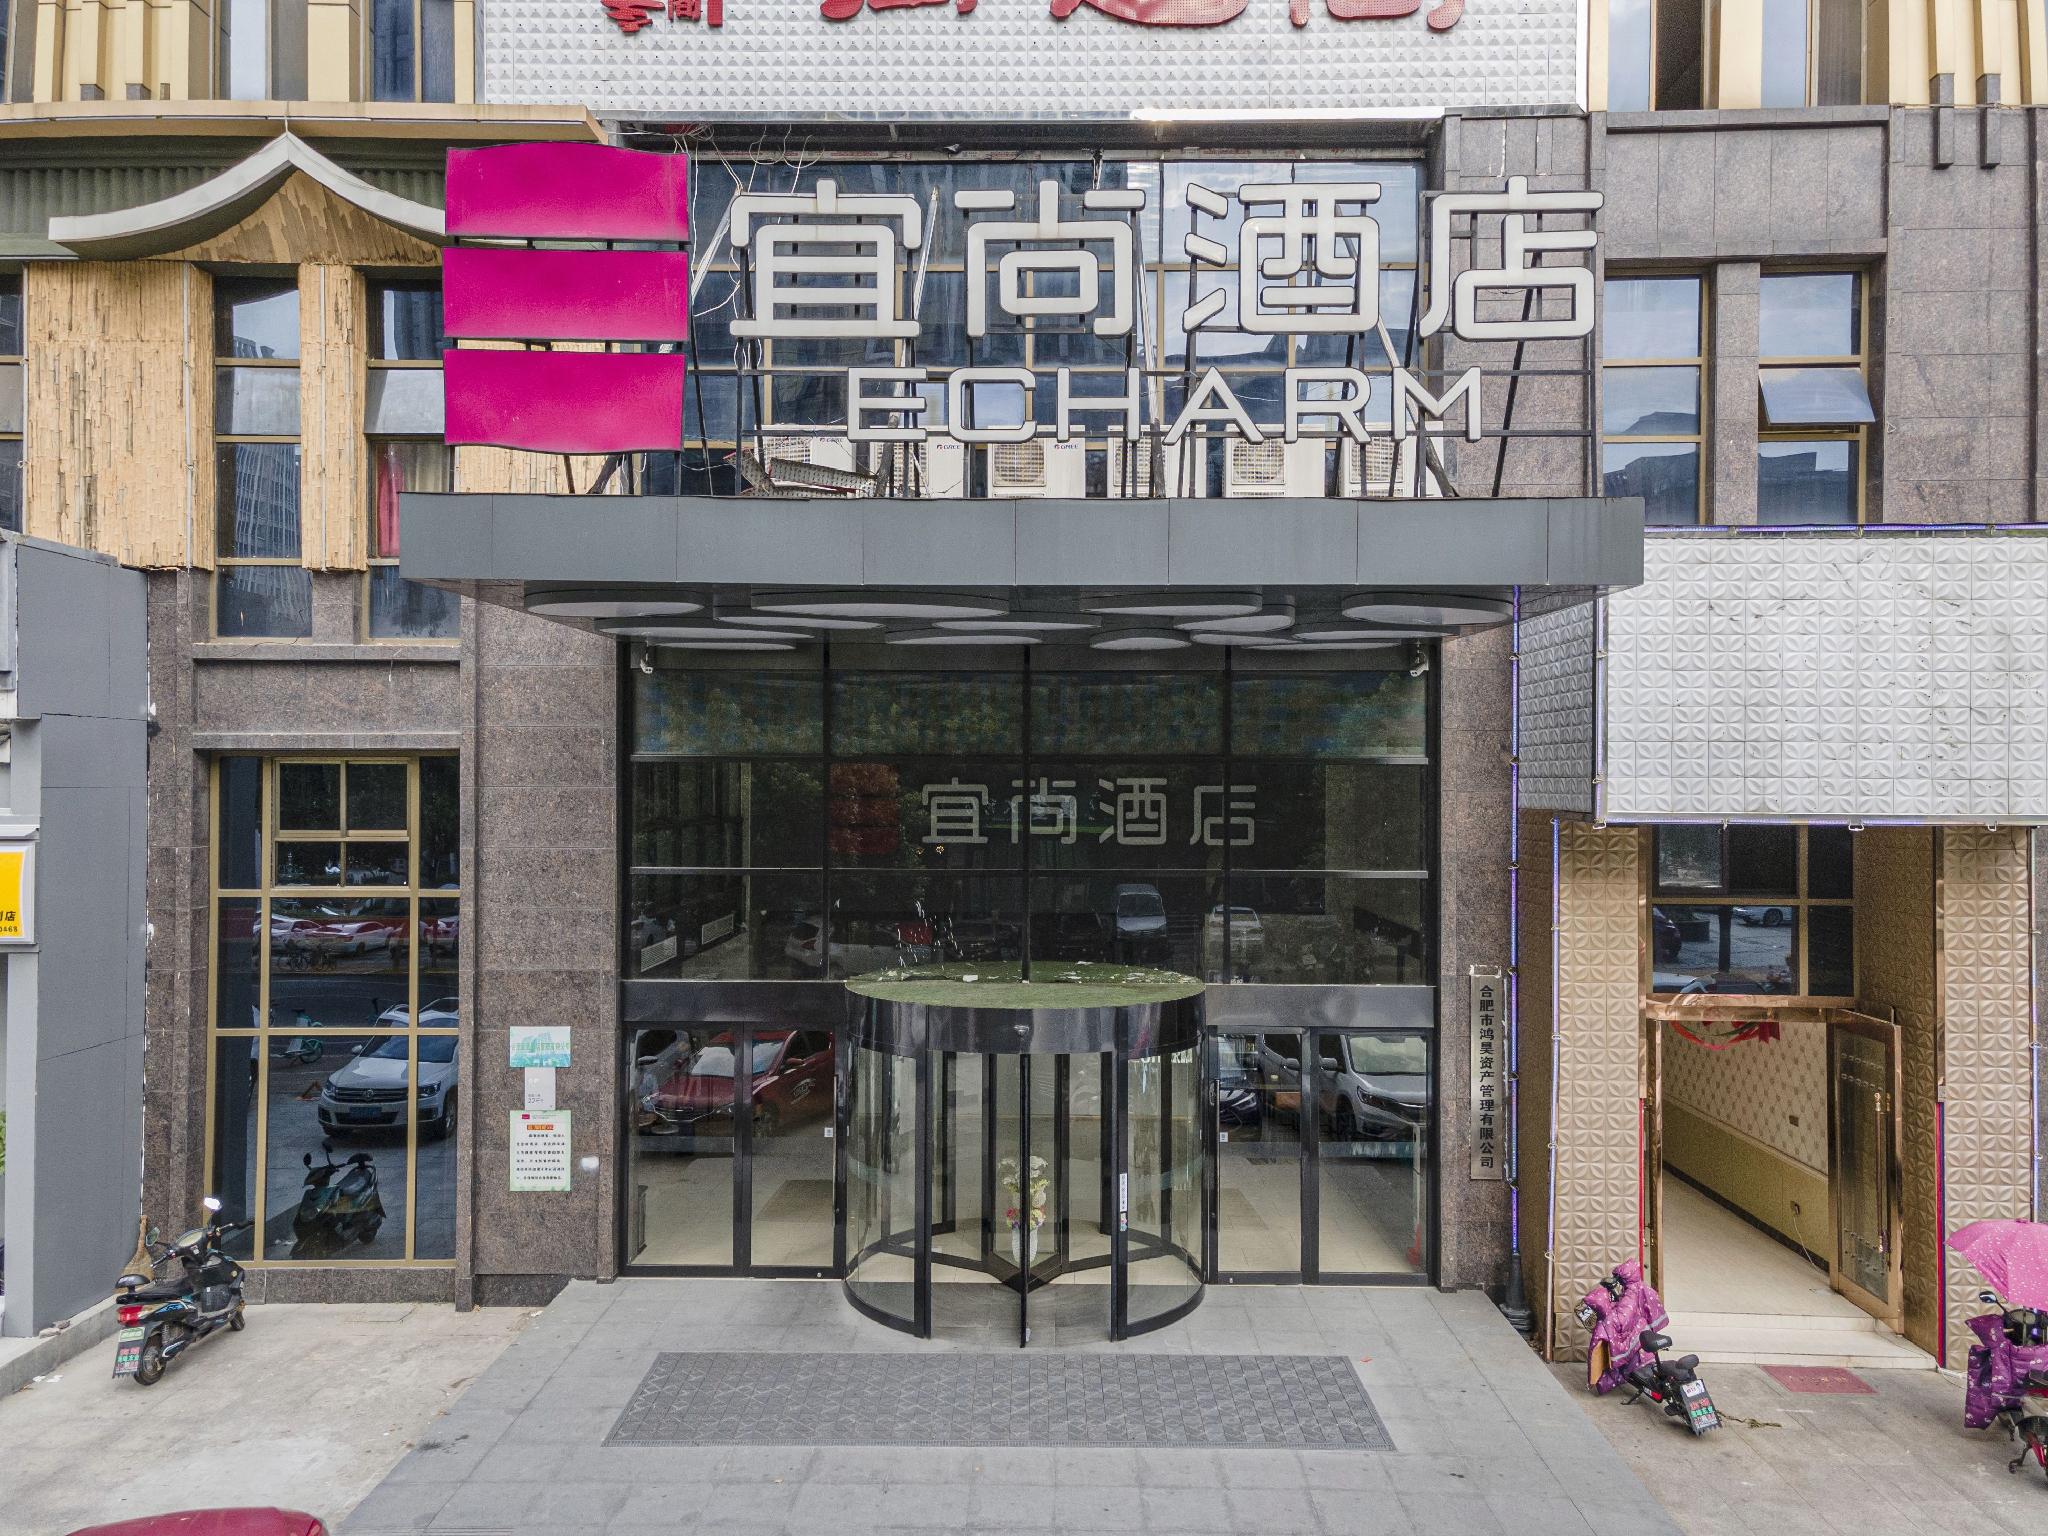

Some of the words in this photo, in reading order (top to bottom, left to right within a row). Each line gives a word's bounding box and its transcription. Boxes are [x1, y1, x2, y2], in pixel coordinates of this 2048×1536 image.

[729, 176, 1605, 341] 宜尚酒店
[847, 366, 1482, 444] ECHARM
[920, 777, 1258, 847] 宜尚酒店
[1480, 984, 1495, 1169] 合肥市鸿昊资产管理有限公司
